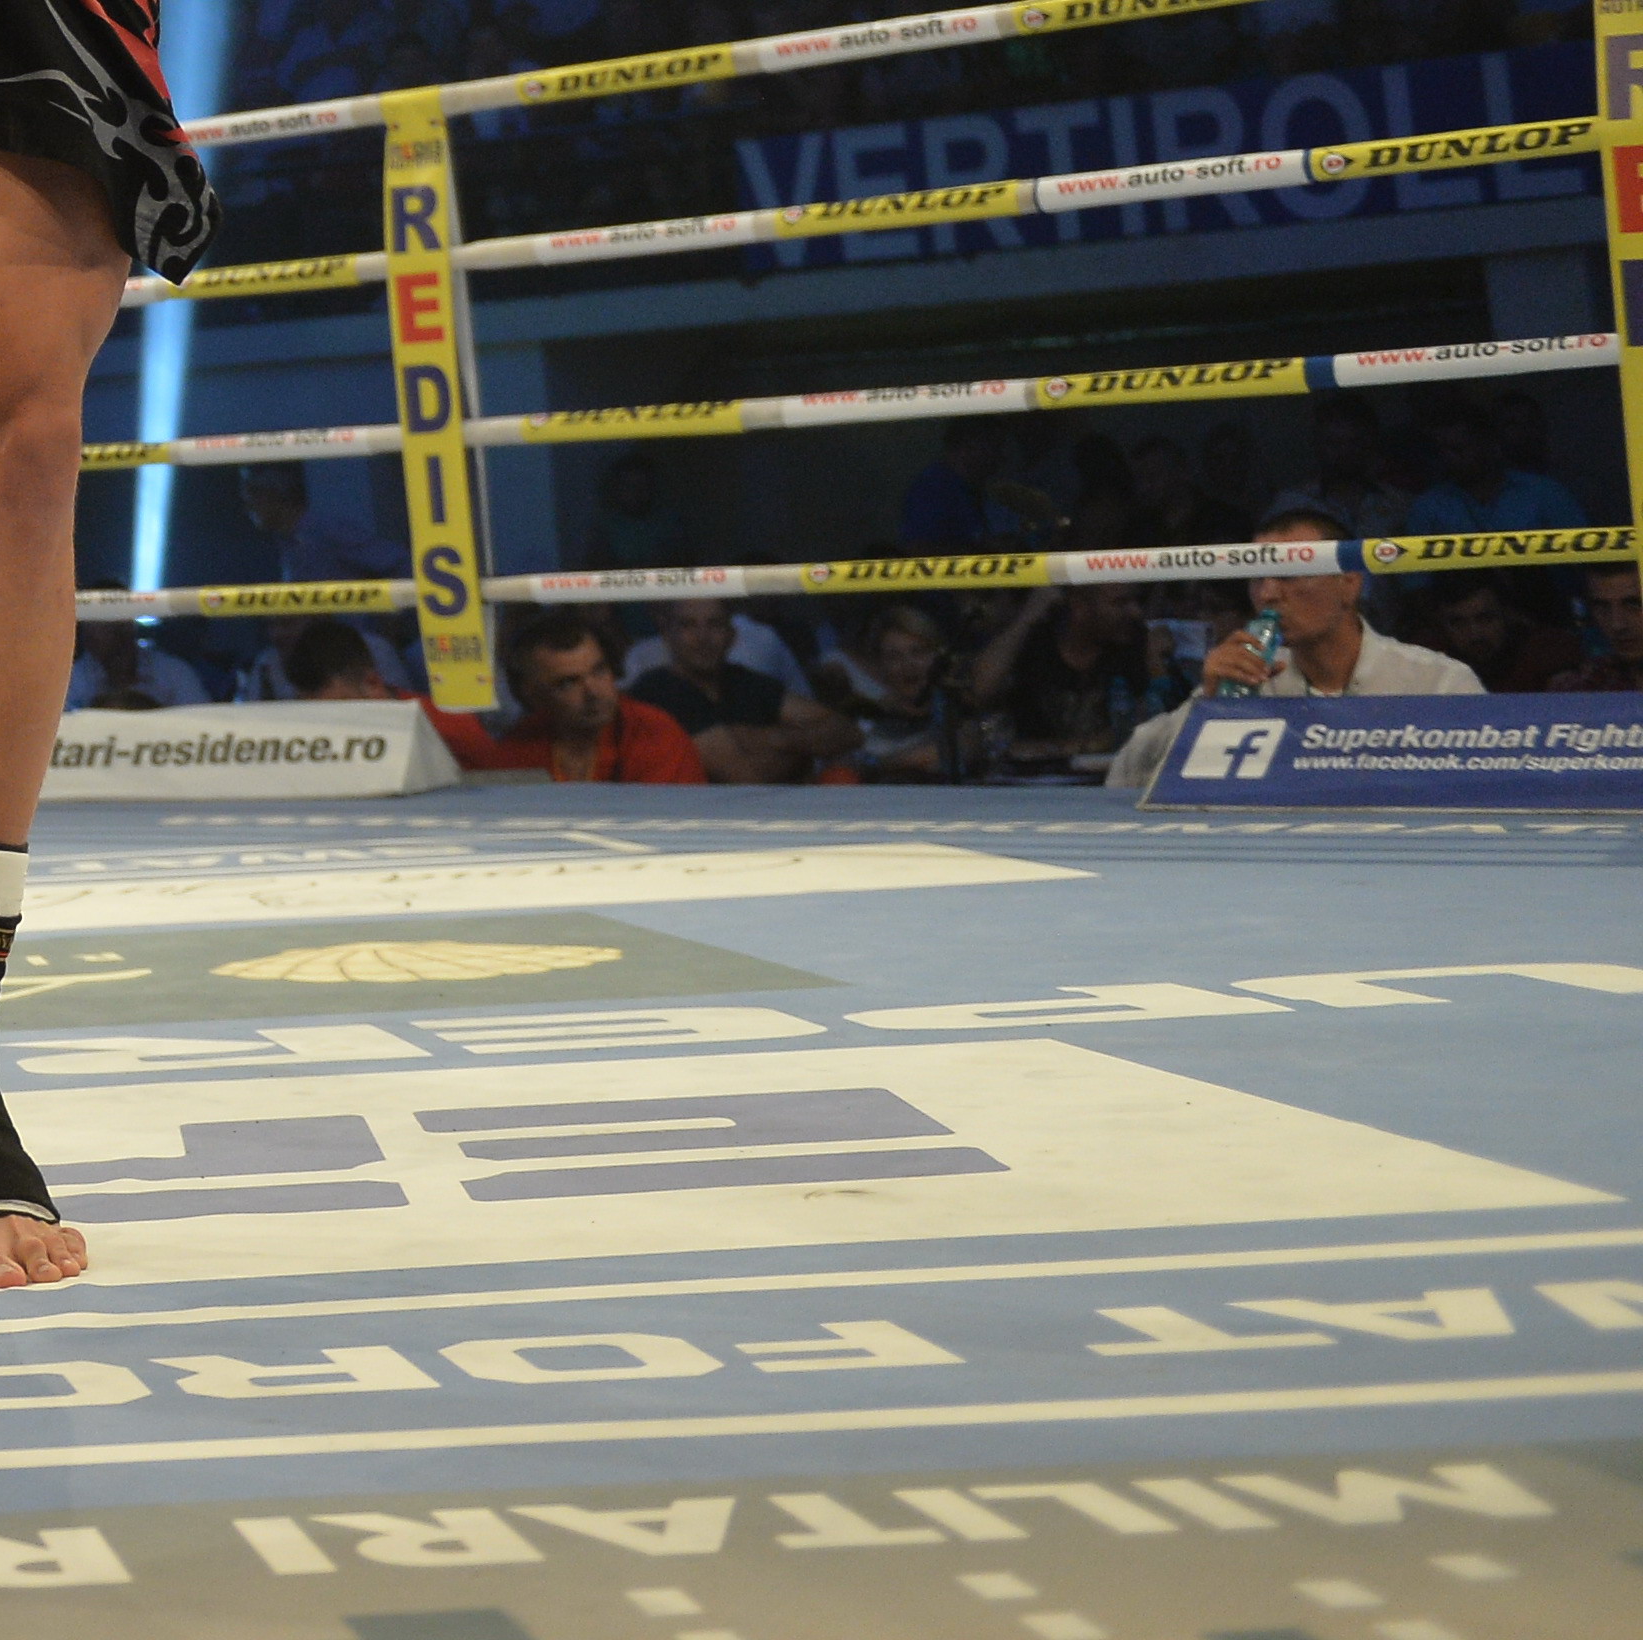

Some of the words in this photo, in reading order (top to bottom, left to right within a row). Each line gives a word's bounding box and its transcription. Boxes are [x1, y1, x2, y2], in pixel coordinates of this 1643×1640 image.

[559, 53, 723, 94] DUNLOP
[1365, 121, 1594, 170] DUNLOP
[1057, 153, 1283, 198] www.auto-soft.ro
[815, 185, 1009, 220] DUNLOP
[1357, 332, 1608, 368] www.auto-soft.ro
[1086, 357, 1293, 394] DUNLOP
[391, 186, 469, 618] REDIS
[847, 557, 1036, 581] DUNLOP
[1086, 543, 1315, 573] www.auto-soft.ro
[236, 585, 383, 612] DUNLOP
[1302, 722, 1539, 754] Superkombat
[231, 1460, 1556, 1576] MILITARI
